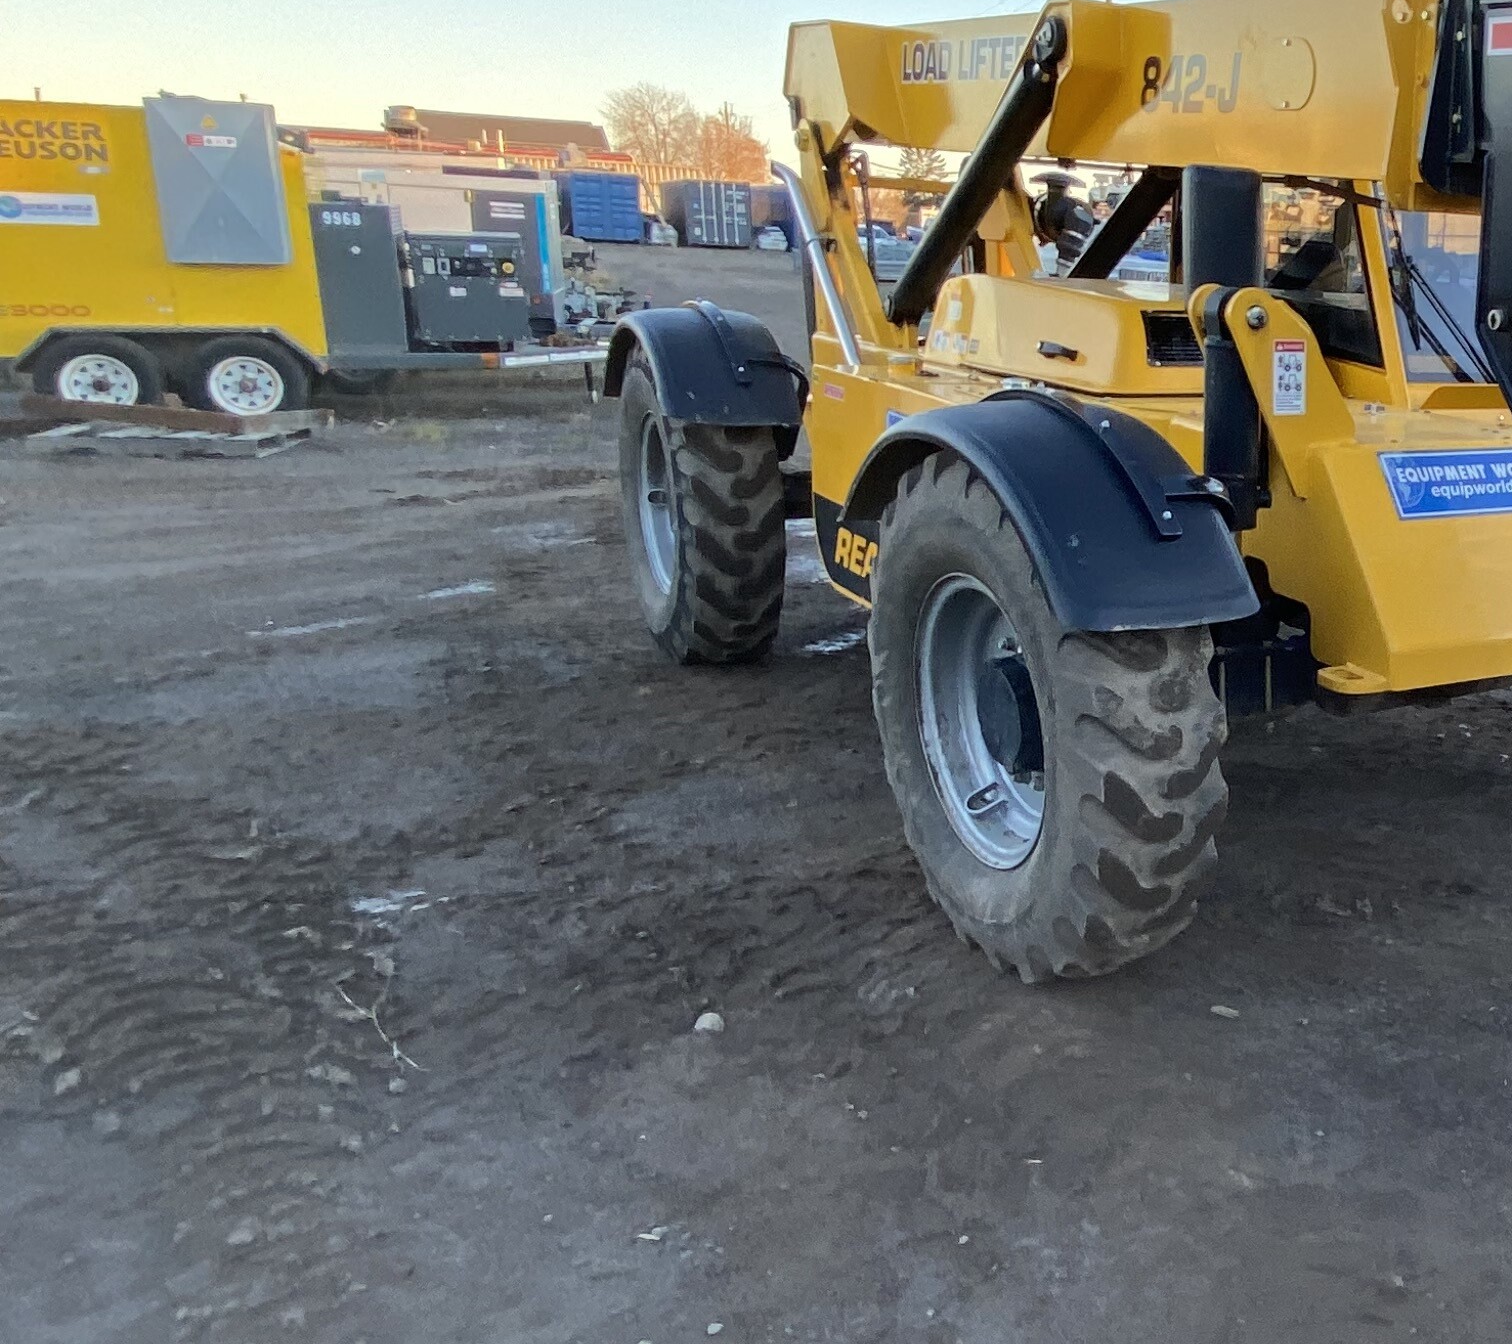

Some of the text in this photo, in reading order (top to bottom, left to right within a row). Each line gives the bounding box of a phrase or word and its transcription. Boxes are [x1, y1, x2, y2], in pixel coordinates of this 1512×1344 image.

[902, 41, 951, 82] LOAD
[1141, 52, 1243, 113] 842-J
[0, 119, 107, 142] ACKER
[0, 139, 109, 162] EUSON
[322, 211, 362, 226] 9968
[1395, 463, 1487, 484] EQUIPMENT
[834, 526, 879, 578] REA
